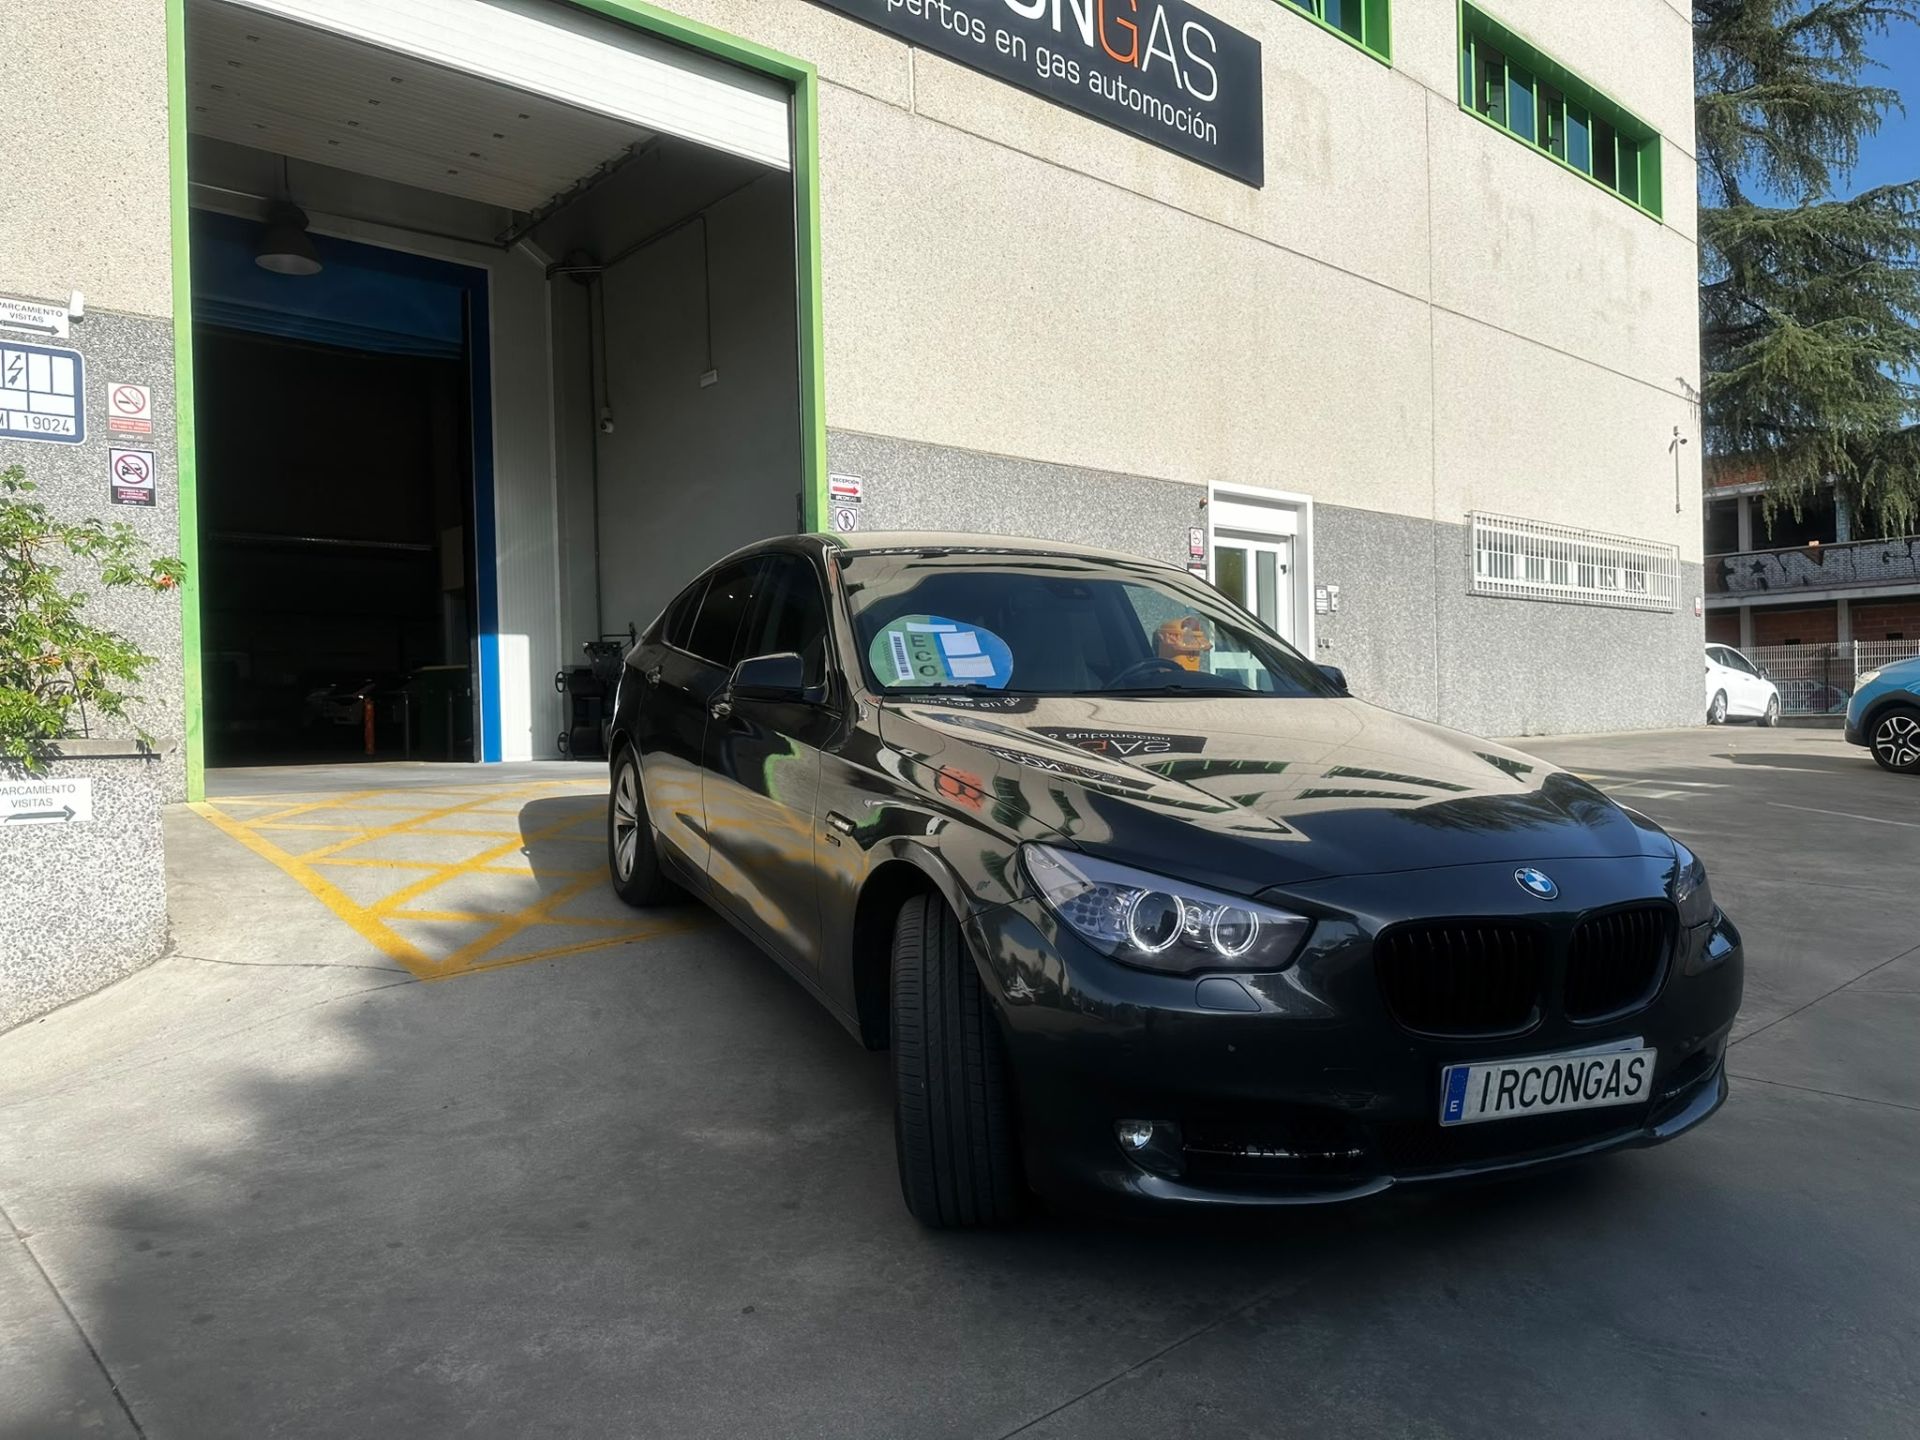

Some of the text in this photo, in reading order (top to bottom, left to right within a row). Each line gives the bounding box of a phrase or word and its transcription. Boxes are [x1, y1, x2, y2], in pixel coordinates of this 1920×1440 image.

[995, 29, 1027, 62] en
[1036, 46, 1080, 84] gas
[1089, 70, 1217, 145] automoción
[0, 302, 63, 317] ARCAMIENTO
[9, 312, 44, 323] VISITAS
[24, 415, 70, 432] 19024
[0, 784, 76, 796] ARCAMIENTO
[11, 798, 53, 809] VISITAS
[1450, 1057, 1645, 1112] E IRCONGAS
